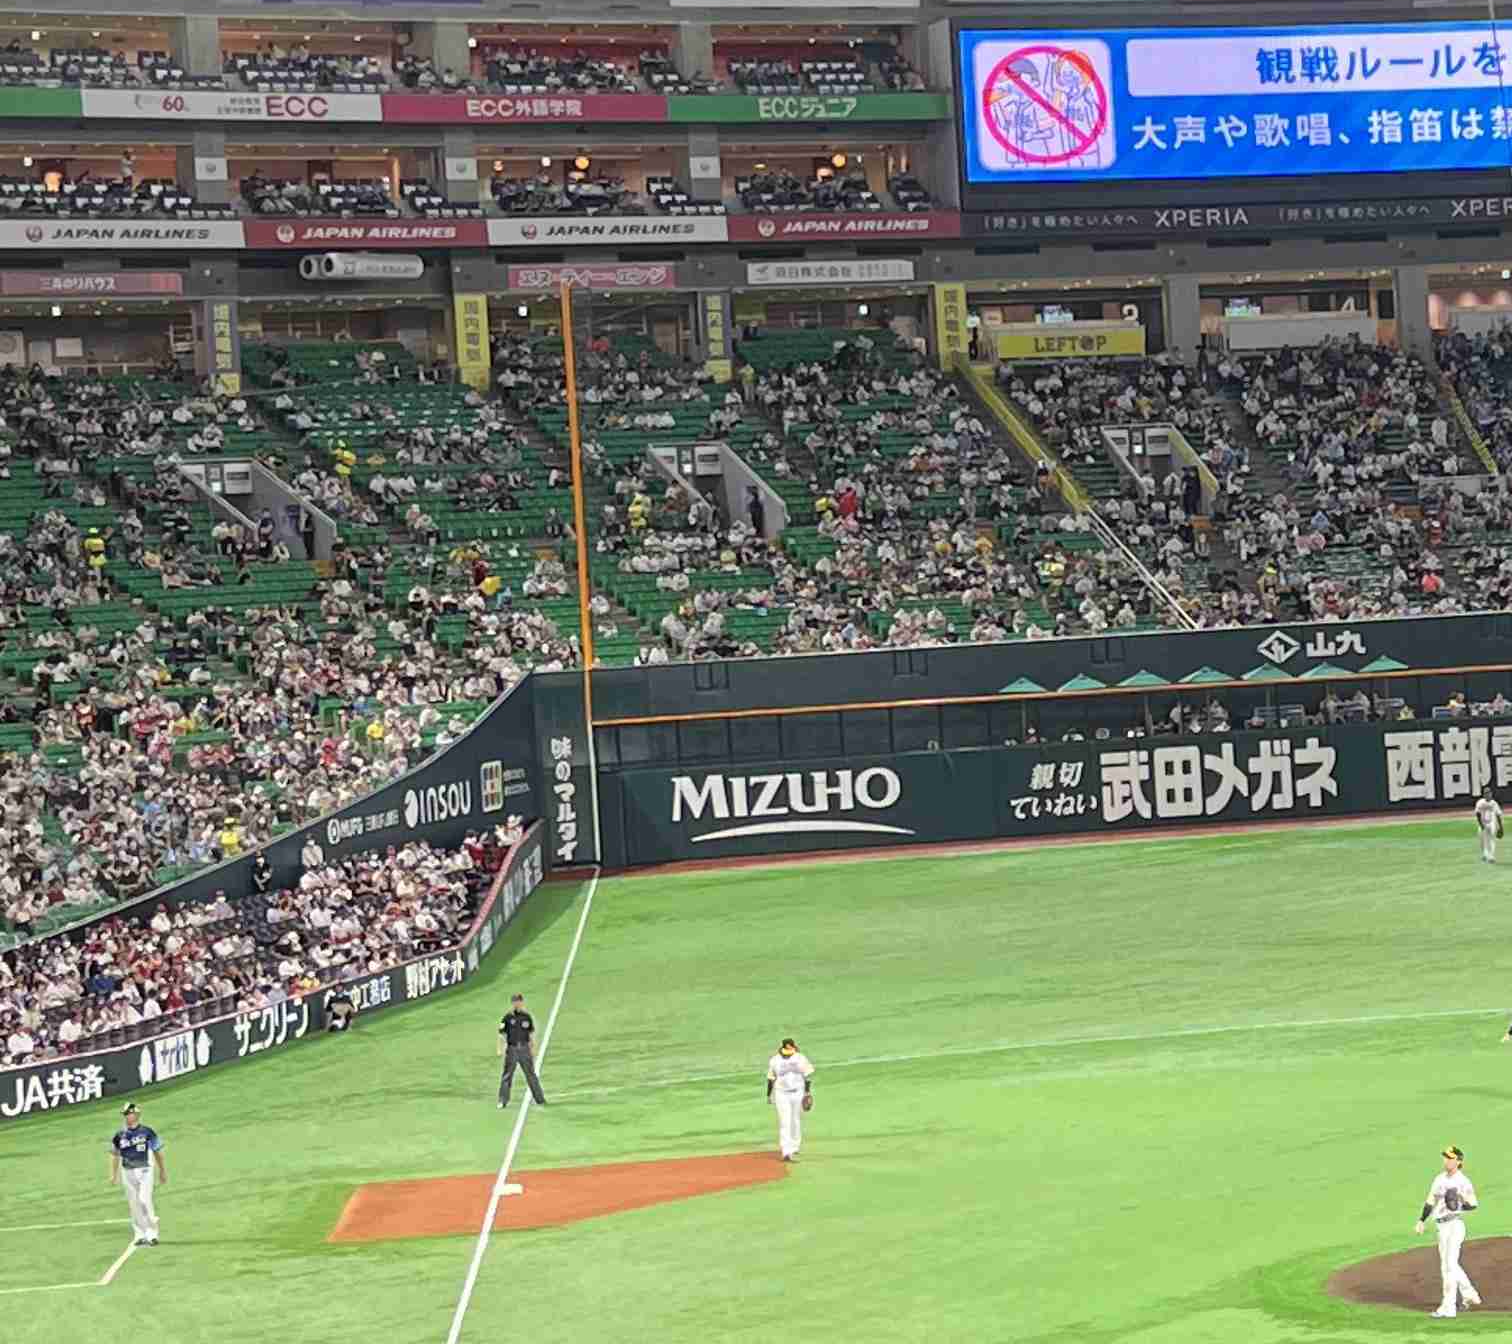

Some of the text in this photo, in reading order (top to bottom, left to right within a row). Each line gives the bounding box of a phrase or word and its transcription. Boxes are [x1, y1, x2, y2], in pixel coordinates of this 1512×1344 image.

[265, 95, 329, 118] ECC
[466, 98, 583, 118] ECC外語学院
[758, 96, 857, 119] ECCジュニア
[545, 223, 695, 237] JAPAN AIRLINES
[782, 218, 929, 233] JAPAN AIRLINES
[1154, 207, 1249, 228] XPERIA
[52, 227, 209, 241] JAPAN AIRLINES
[302, 226, 457, 239] JAPAN AIRLINES
[1305, 630, 1367, 658] 山九
[1030, 760, 1085, 791] 親切
[1099, 738, 1338, 823] 武田メガネ
[550, 735, 579, 862] 味のマルタイ
[671, 766, 902, 823] MIZUHO
[1009, 795, 1099, 821] ていねい
[345, 975, 392, 1012] 中工務店
[233, 996, 310, 1057] サニクリーン
[1, 1064, 104, 1117] JA共済
